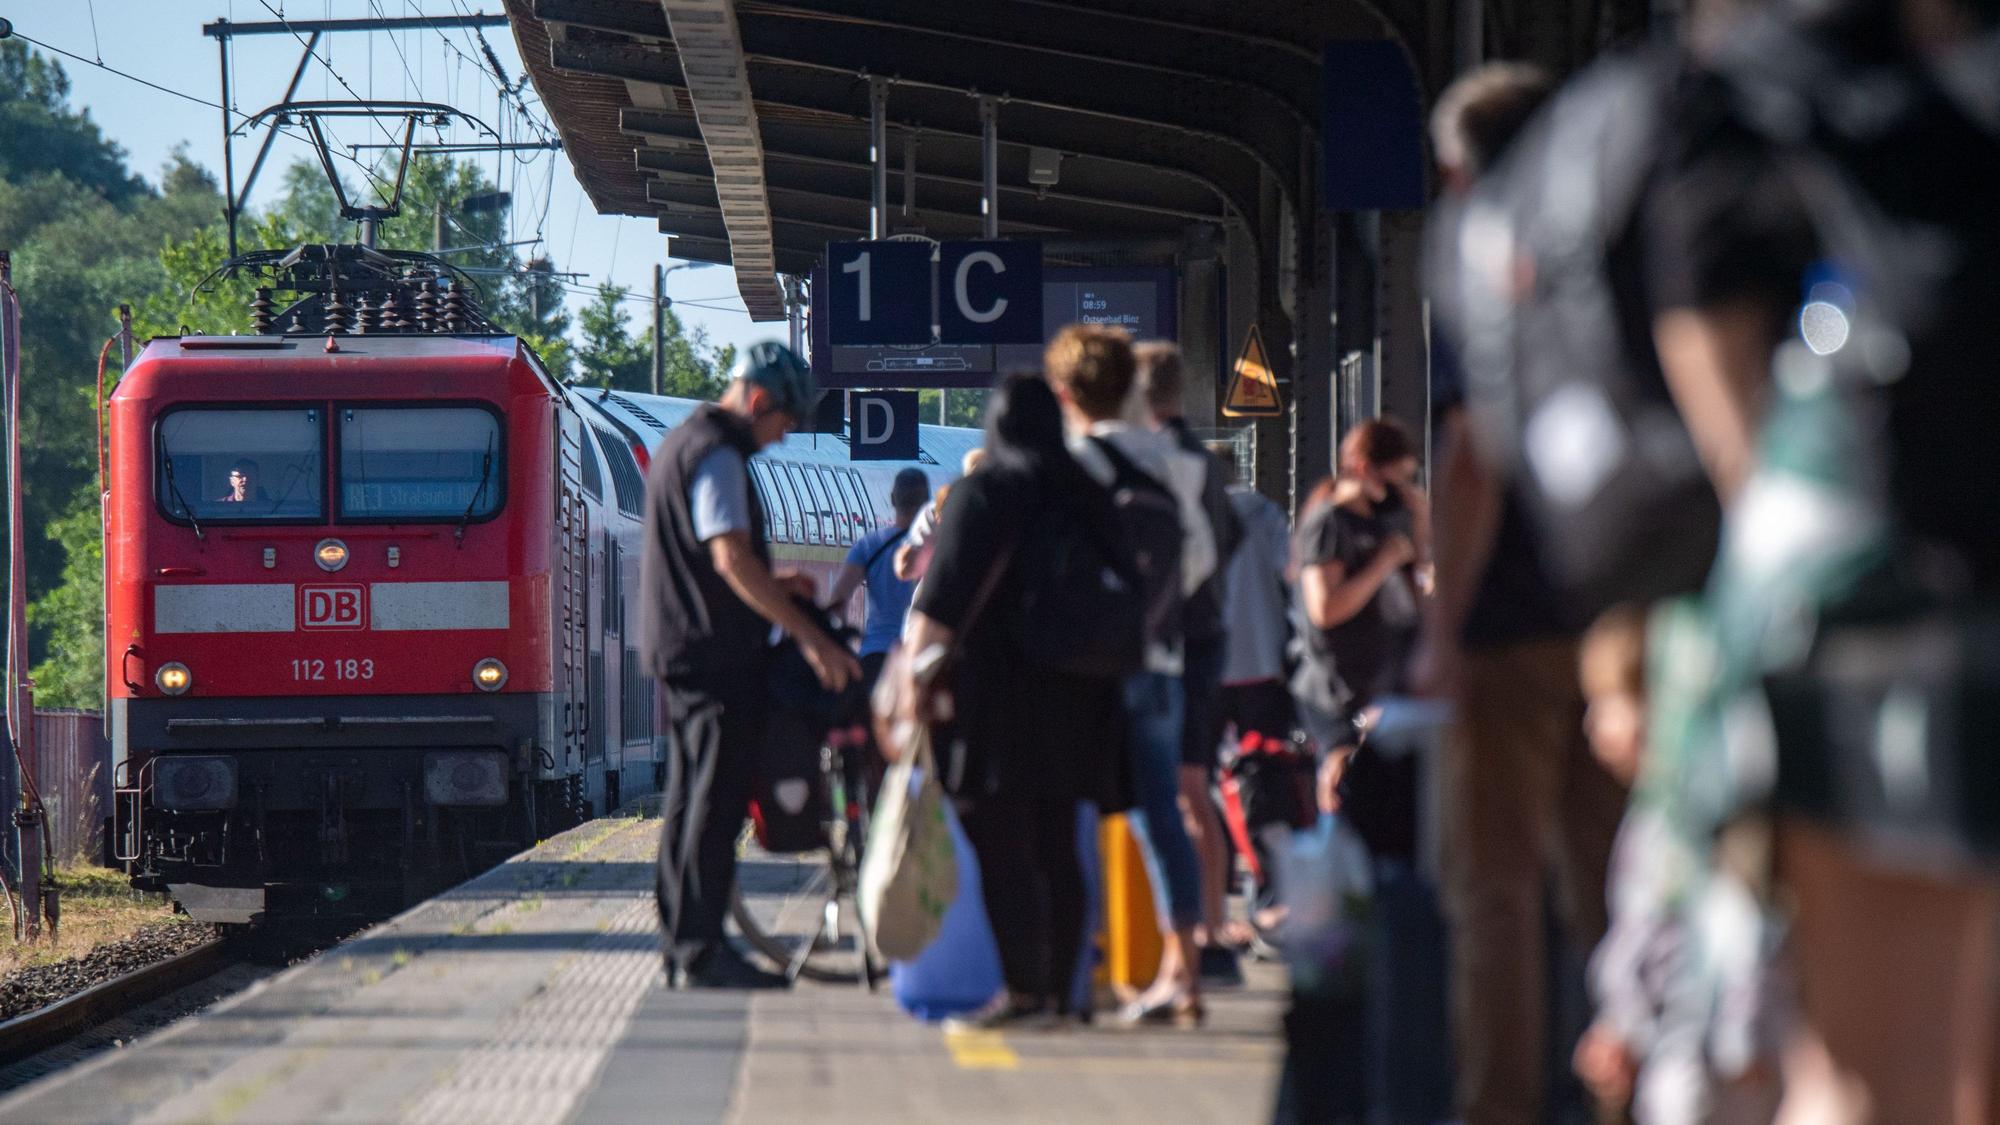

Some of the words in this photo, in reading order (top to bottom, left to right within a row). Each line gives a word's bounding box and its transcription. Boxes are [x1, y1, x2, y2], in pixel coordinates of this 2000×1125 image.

[843, 252, 871, 321] 1
[955, 251, 1008, 323] C
[1083, 300, 1106, 310] 08:59
[1123, 314, 1139, 324] Binz
[860, 398, 895, 444] D
[309, 592, 358, 622] DB
[292, 659, 325, 680] 112
[335, 659, 374, 680] 183
